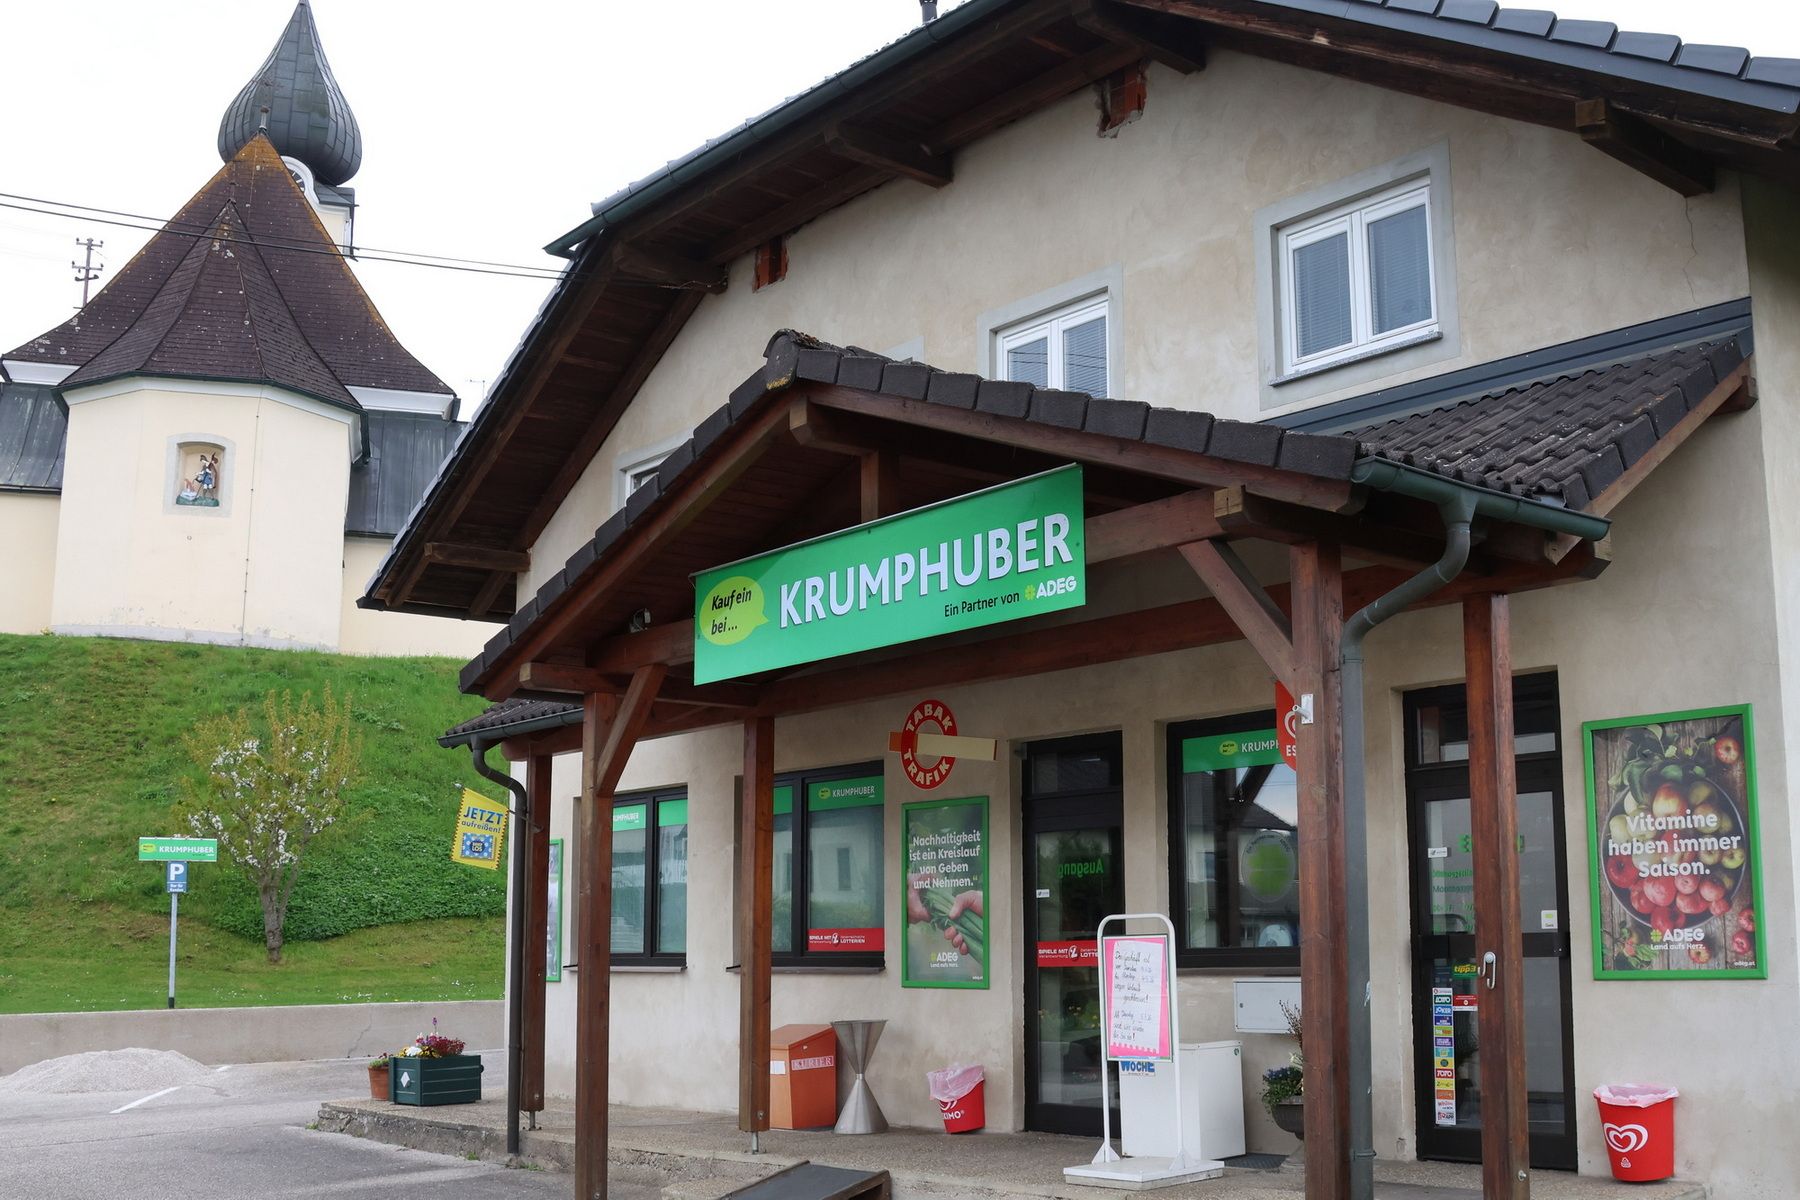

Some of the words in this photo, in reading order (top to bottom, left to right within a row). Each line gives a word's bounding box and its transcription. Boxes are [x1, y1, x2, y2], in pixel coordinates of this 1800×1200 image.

[779, 512, 1073, 628] KRUMPHUBER
[944, 605, 959, 617] Ein
[961, 597, 998, 613] Partner
[1001, 592, 1020, 605] von
[1036, 575, 1077, 599] ADEG
[905, 703, 953, 732] TABAK
[903, 748, 951, 785] TRAFIK
[832, 786, 875, 798] KRUMPHUBER
[463, 806, 504, 825] JETZT
[1625, 809, 1718, 832] Vitamine
[461, 820, 501, 834] aufreißen!
[912, 829, 981, 847] Nachhaltigkeit
[1608, 837, 1669, 856] haben
[1674, 833, 1741, 853] immer
[159, 846, 215, 854] KRUMPHUBER
[909, 850, 921, 861] ist
[922, 848, 936, 860] ein
[938, 845, 981, 859] Kreislauf
[170, 863, 185, 881] P
[920, 865, 937, 874] von
[938, 862, 969, 873] Geben
[1638, 857, 1711, 878] Saison.
[913, 878, 930, 889] und
[1662, 928, 1705, 942] ADEG
[937, 952, 958, 962] ADEG
